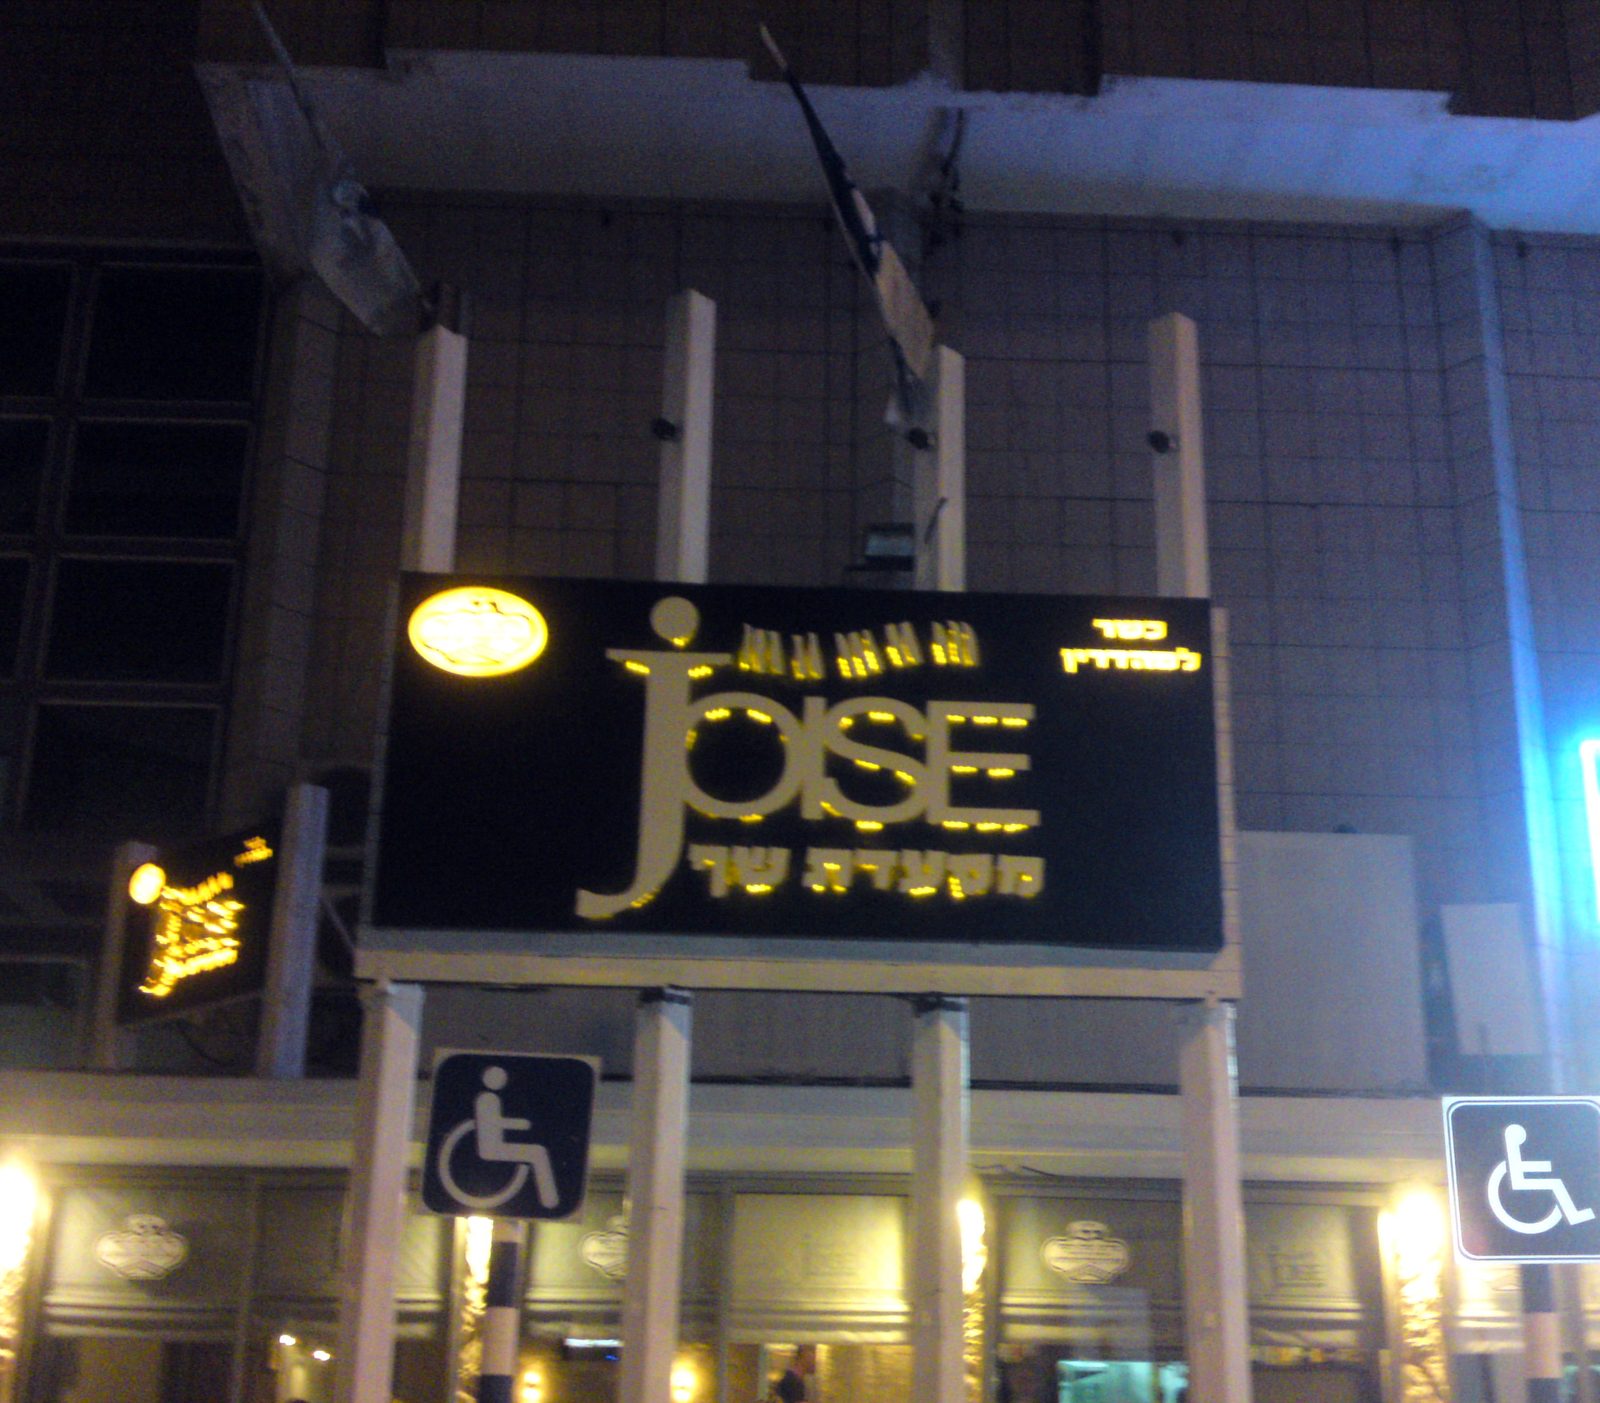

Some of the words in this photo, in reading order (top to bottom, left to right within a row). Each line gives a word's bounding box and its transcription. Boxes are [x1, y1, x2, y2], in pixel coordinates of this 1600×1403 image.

[1092, 618, 1168, 640] כשר
[1059, 646, 1202, 674] למהדרין
[687, 843, 792, 898] שף
[802, 846, 1046, 899] מסעדת
